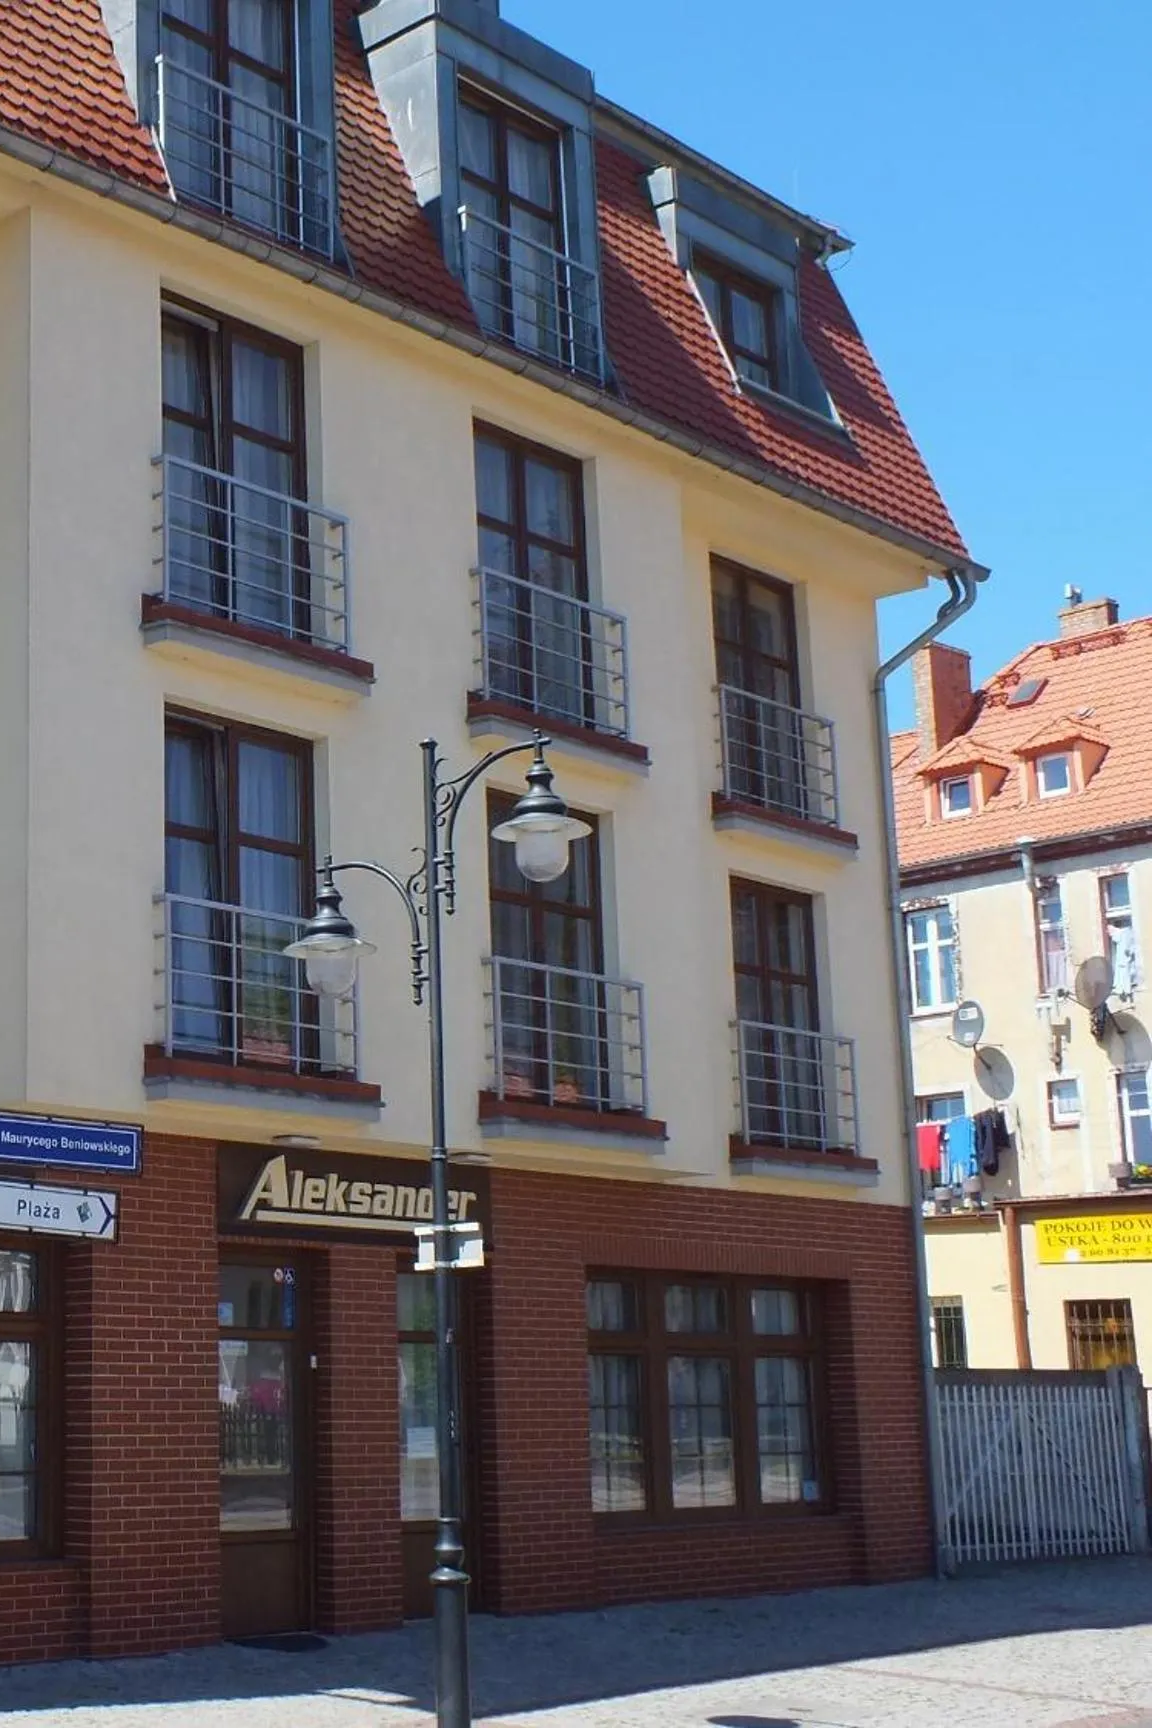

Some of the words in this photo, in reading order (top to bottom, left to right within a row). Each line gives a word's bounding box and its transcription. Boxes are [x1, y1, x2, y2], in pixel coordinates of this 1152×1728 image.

[1, 1130, 58, 1149] Maurycego
[60, 1138, 131, 1156] Beniowskiego
[16, 1199, 60, 1219] Plaża
[1111, 1219, 1135, 1231] DO
